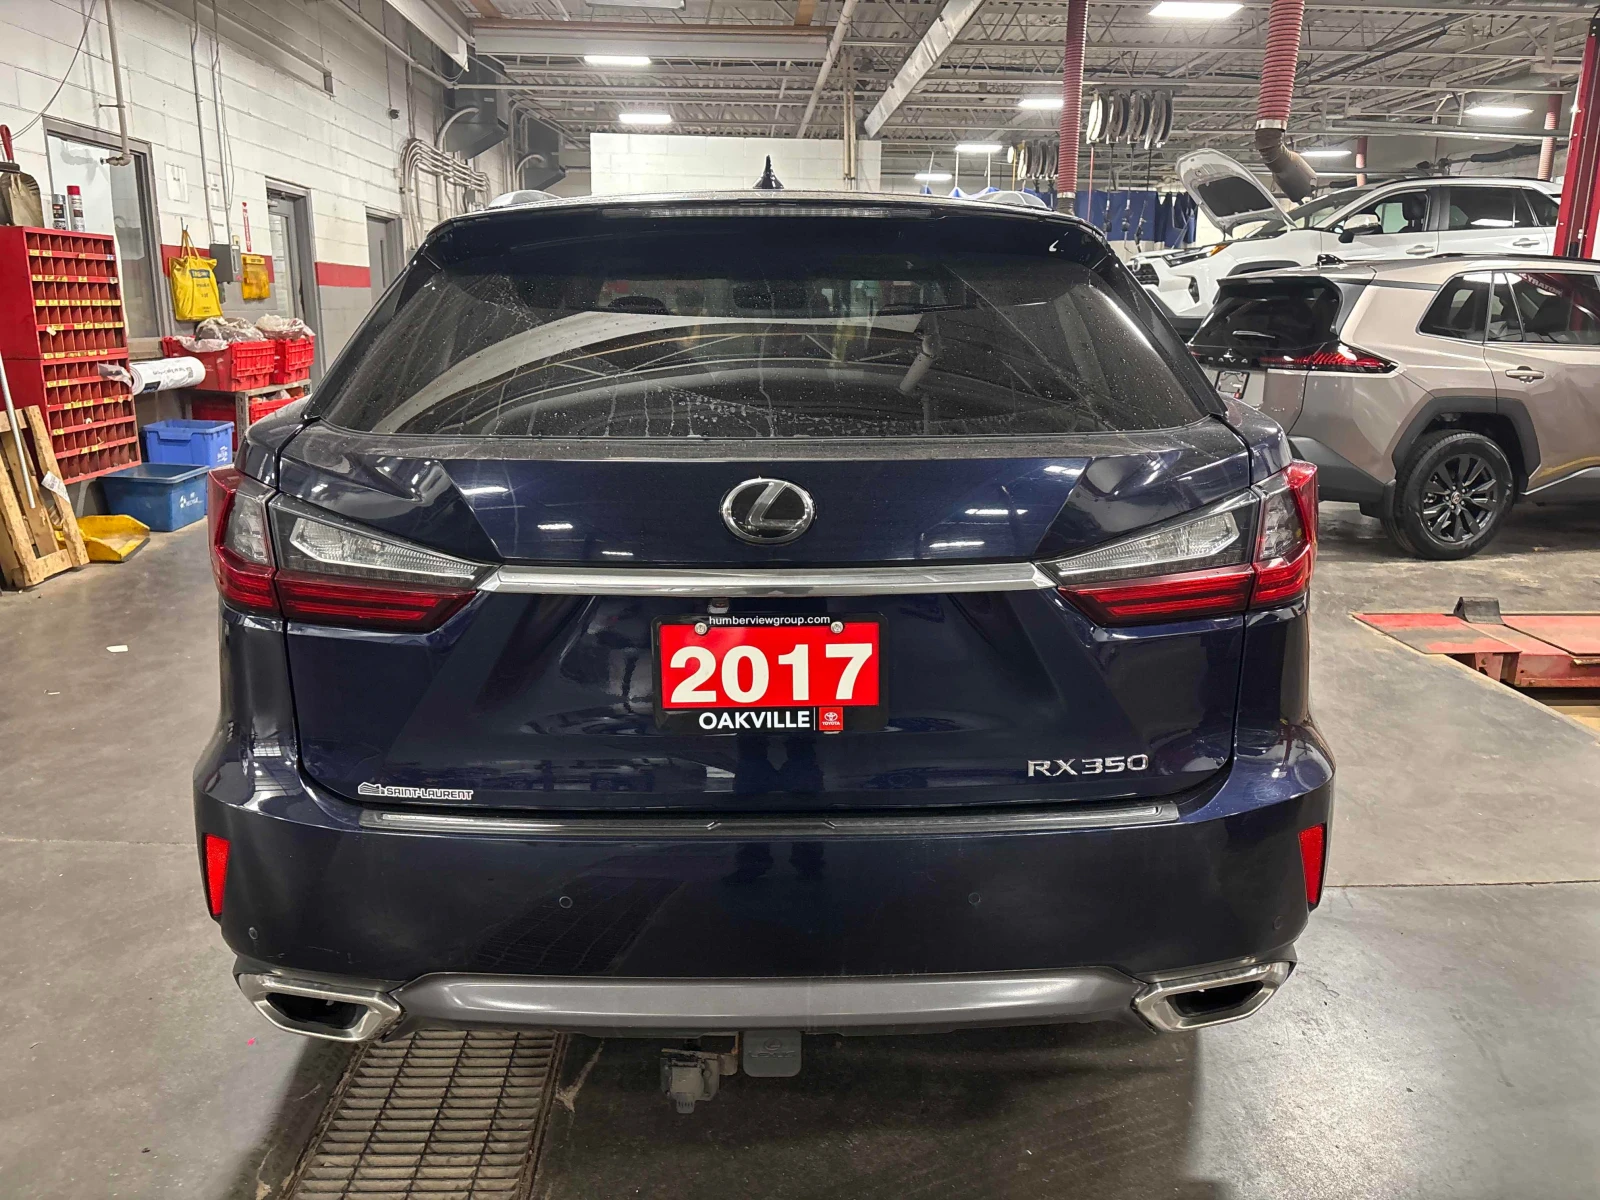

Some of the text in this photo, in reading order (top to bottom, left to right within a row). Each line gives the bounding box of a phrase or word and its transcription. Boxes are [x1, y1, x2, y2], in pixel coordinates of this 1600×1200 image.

[709, 616, 831, 626] humberviewgroup.com
[670, 643, 873, 703] 2017
[698, 711, 810, 730] OAKVILLE
[1027, 753, 1149, 777] RX 350
[386, 786, 474, 800] SAINT-LAURENT
